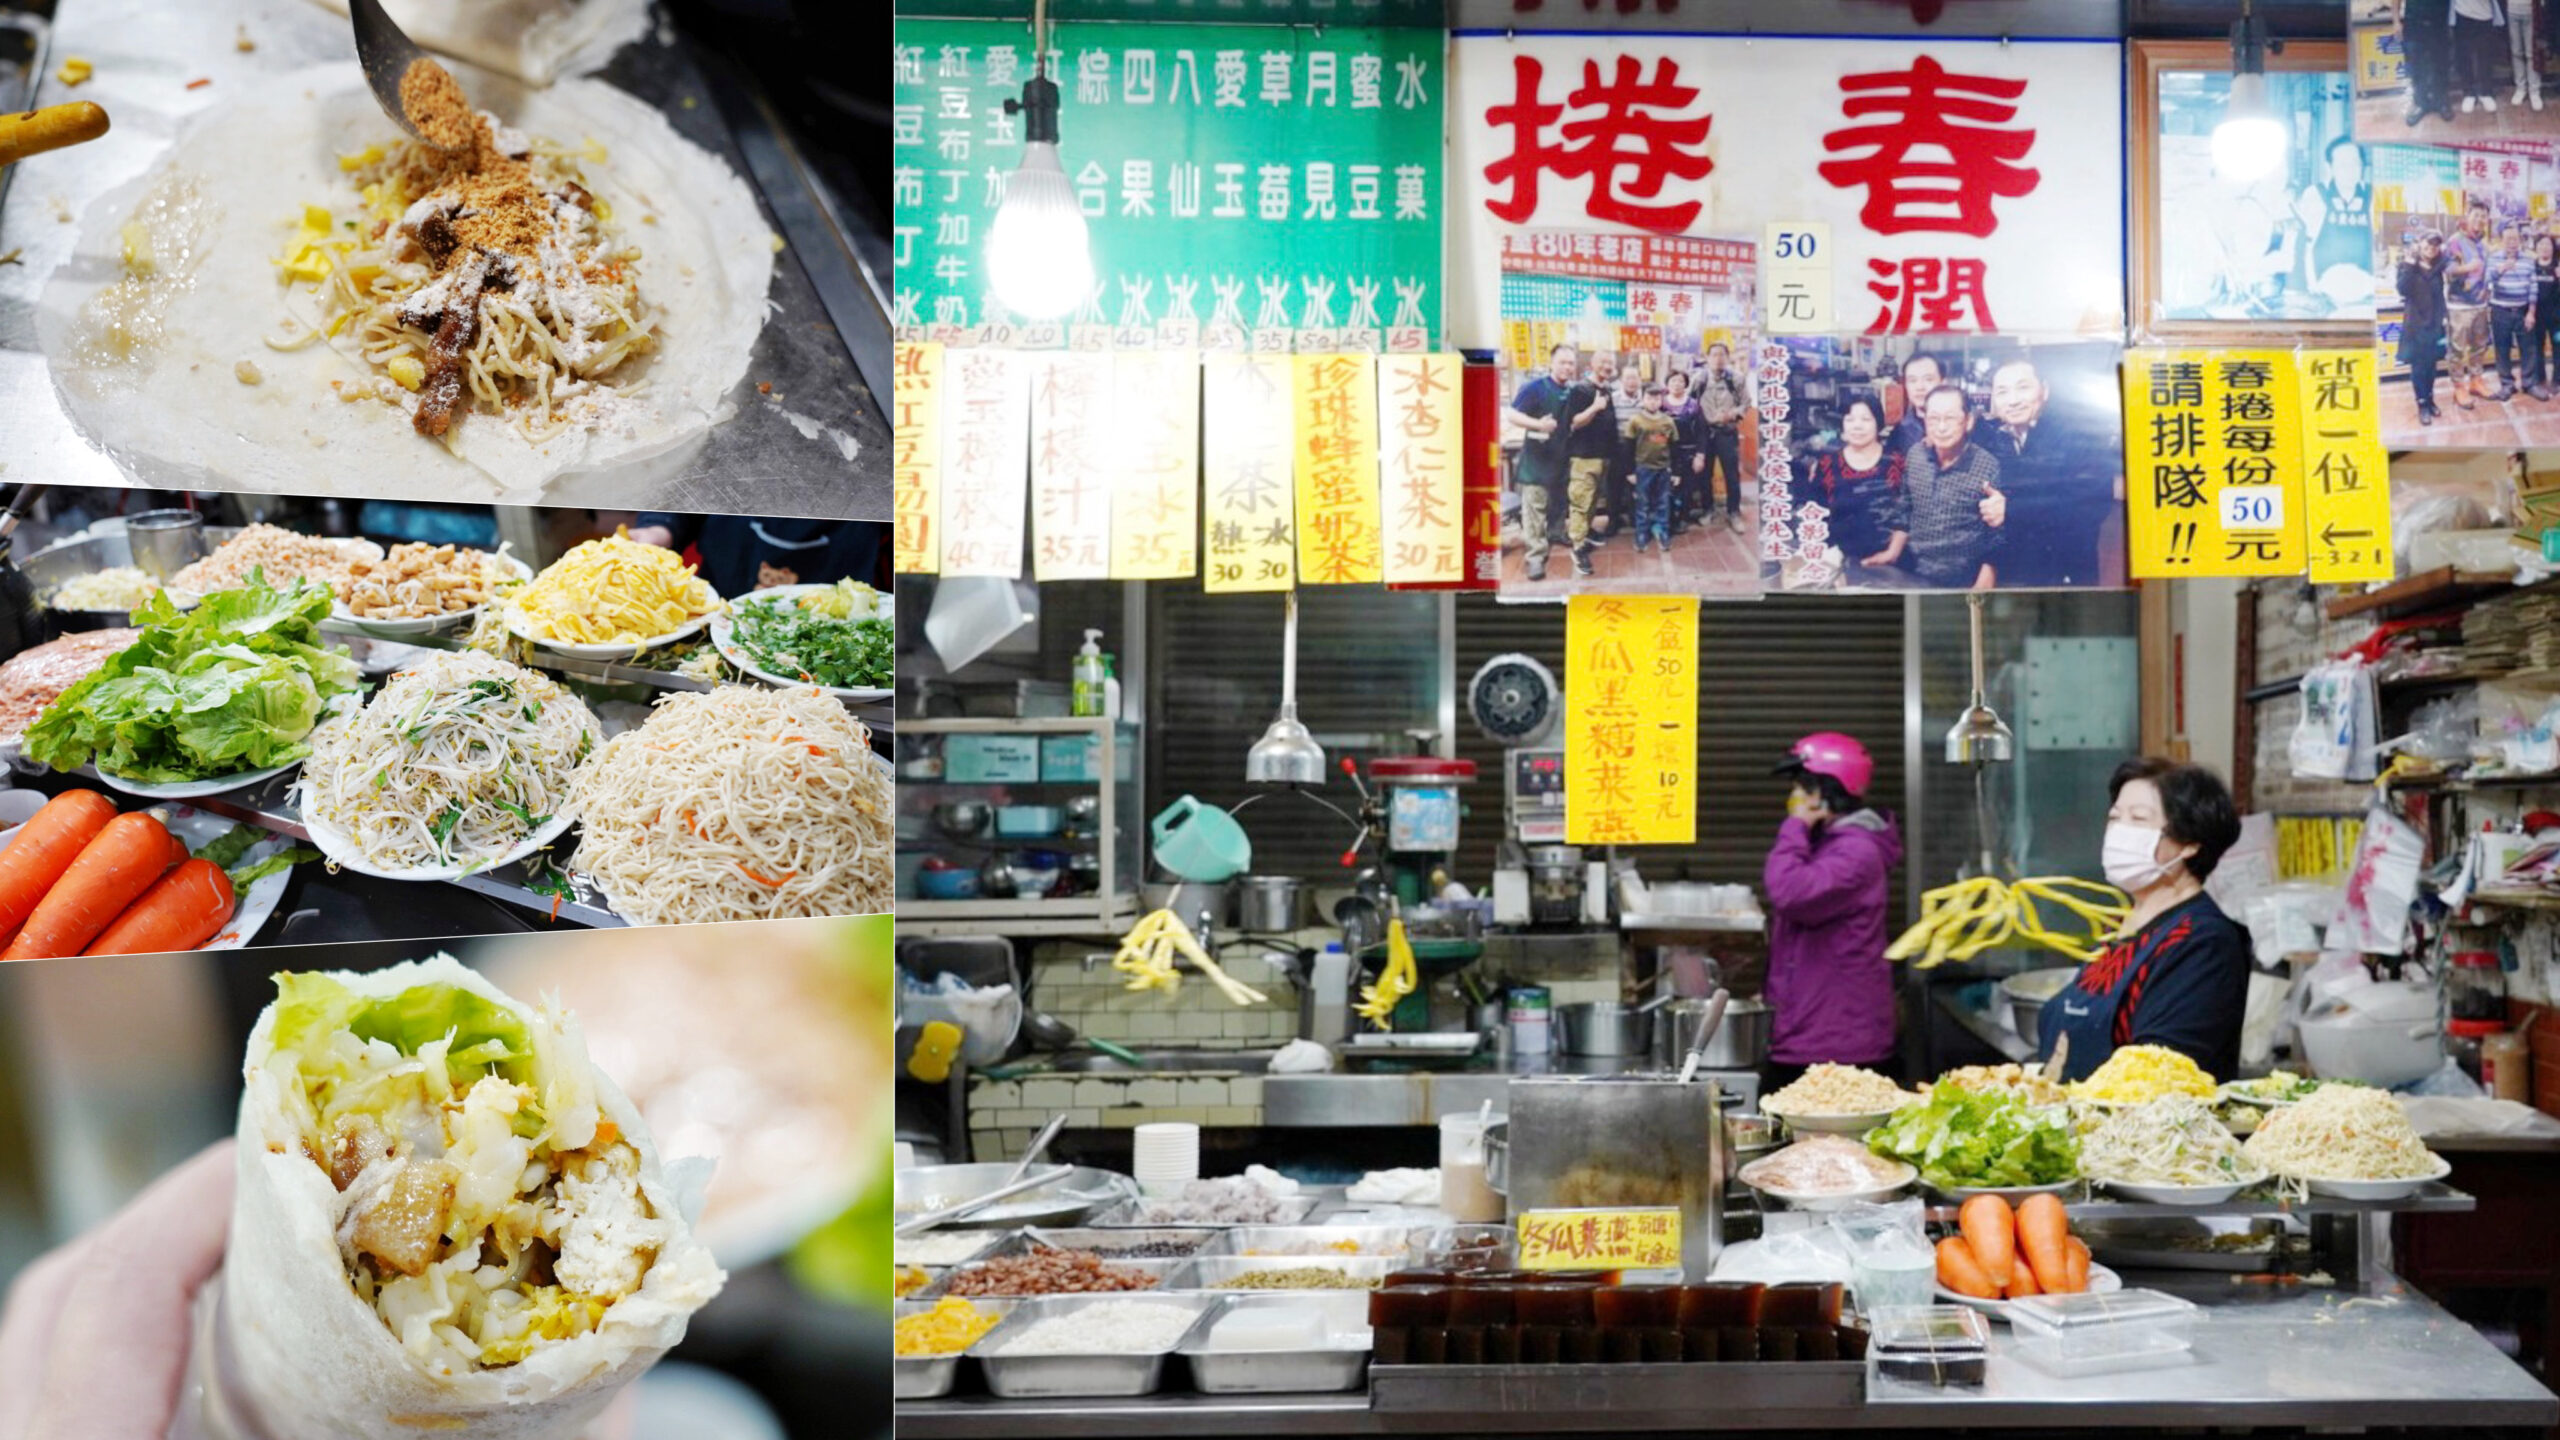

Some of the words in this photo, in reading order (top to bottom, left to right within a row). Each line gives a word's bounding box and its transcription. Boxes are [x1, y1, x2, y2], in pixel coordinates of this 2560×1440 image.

[933, 44, 971, 327] 紅豆布丁加牛奶
[1120, 49, 1158, 327] 四果冰
[1163, 50, 1202, 327] 八仙冰
[1211, 50, 1248, 328] 愛玉冰
[1303, 51, 1338, 328] 月見冰
[1348, 52, 1383, 329] 蜜豆冰
[1393, 53, 1430, 329] 水菓冰
[978, 325, 1011, 345] 40
[1116, 329, 1147, 347] 40
[1259, 332, 1283, 351] 35
[1390, 328, 1422, 350] 45
[1864, 258, 1999, 335] 潤
[1038, 361, 1103, 527] 檸檬汁
[1307, 356, 1365, 584] 珍珠蜂蜜奶茶
[1761, 345, 1792, 560] 與新北市市長侯友宜先生
[2150, 362, 2208, 563] 請排隊!!
[2219, 361, 2281, 561] 春捲每份50元
[2310, 357, 2368, 496] 第一位
[1040, 534, 1104, 567] 35元
[1210, 519, 1249, 554] 熱
[1213, 563, 1243, 583] 30
[1256, 559, 1288, 580] 30
[1393, 542, 1460, 575] 30元
[1798, 501, 1829, 584] 合影留念
